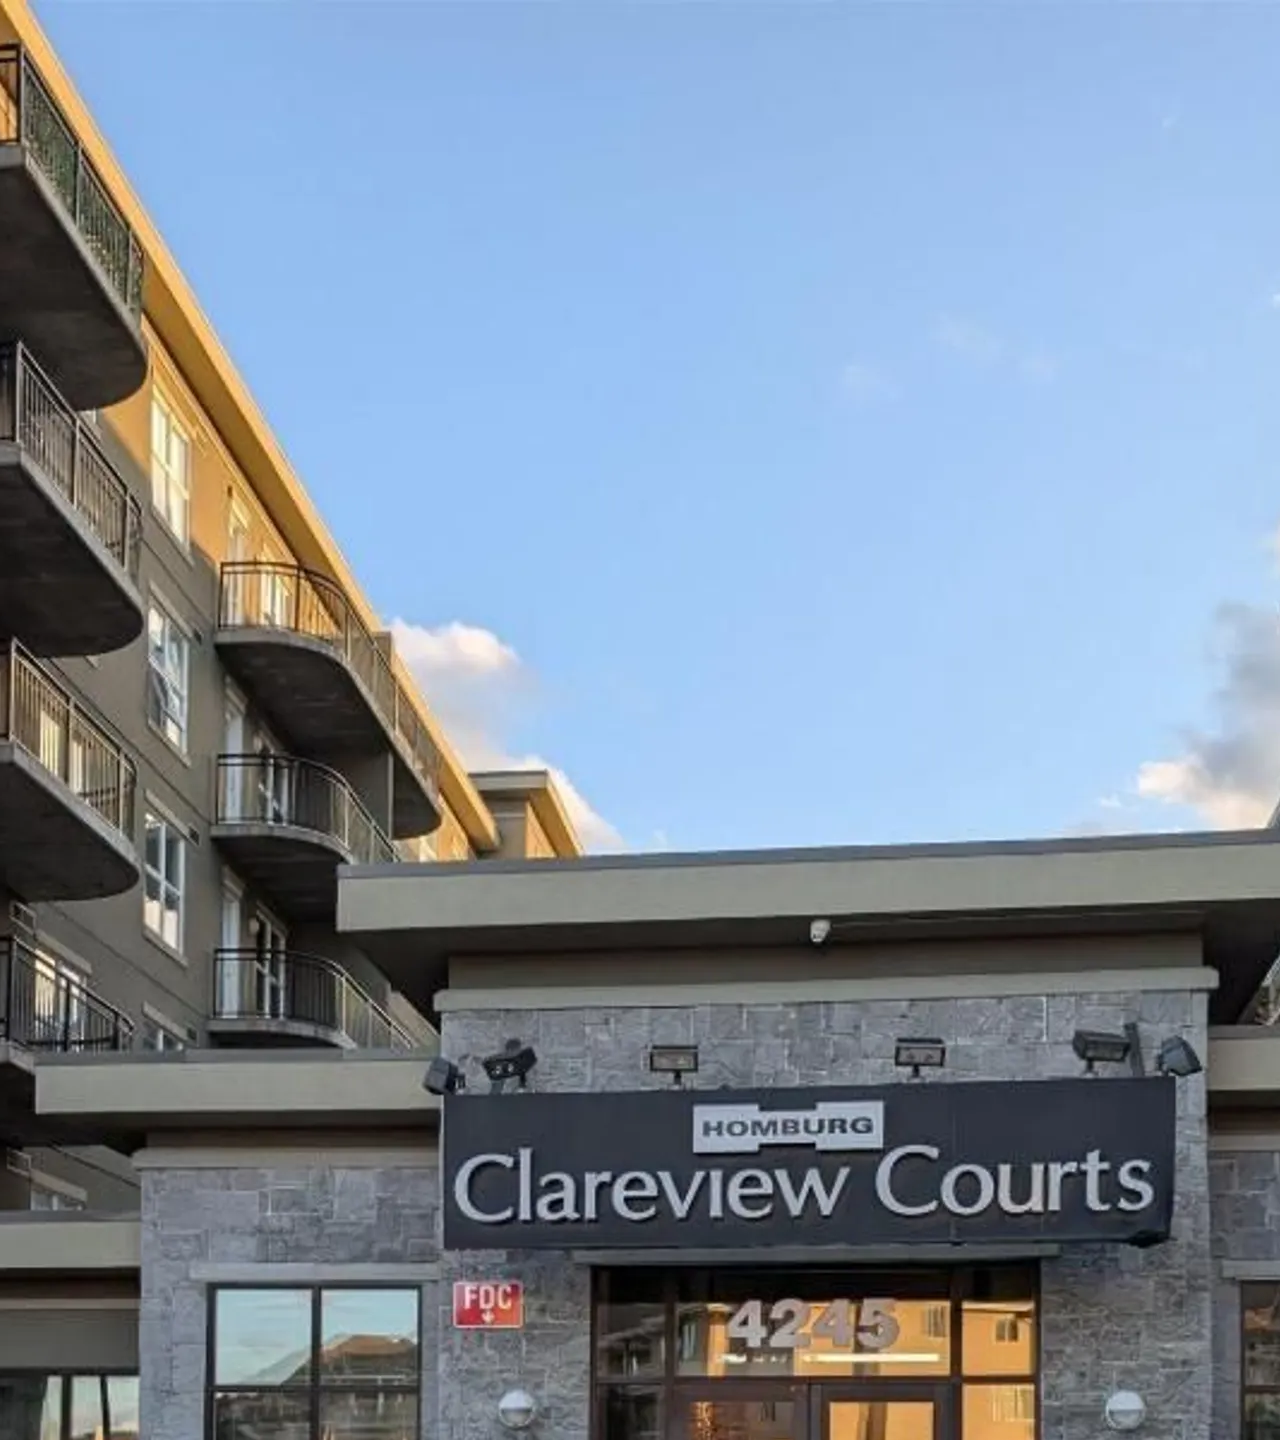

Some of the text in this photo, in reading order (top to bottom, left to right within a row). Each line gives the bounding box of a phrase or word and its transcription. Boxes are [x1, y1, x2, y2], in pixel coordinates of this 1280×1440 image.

[702, 1117, 874, 1137] HOMBURG
[454, 1145, 1155, 1223] Clareview Courts
[464, 1285, 512, 1310] FDC
[728, 1298, 900, 1348] 4245
